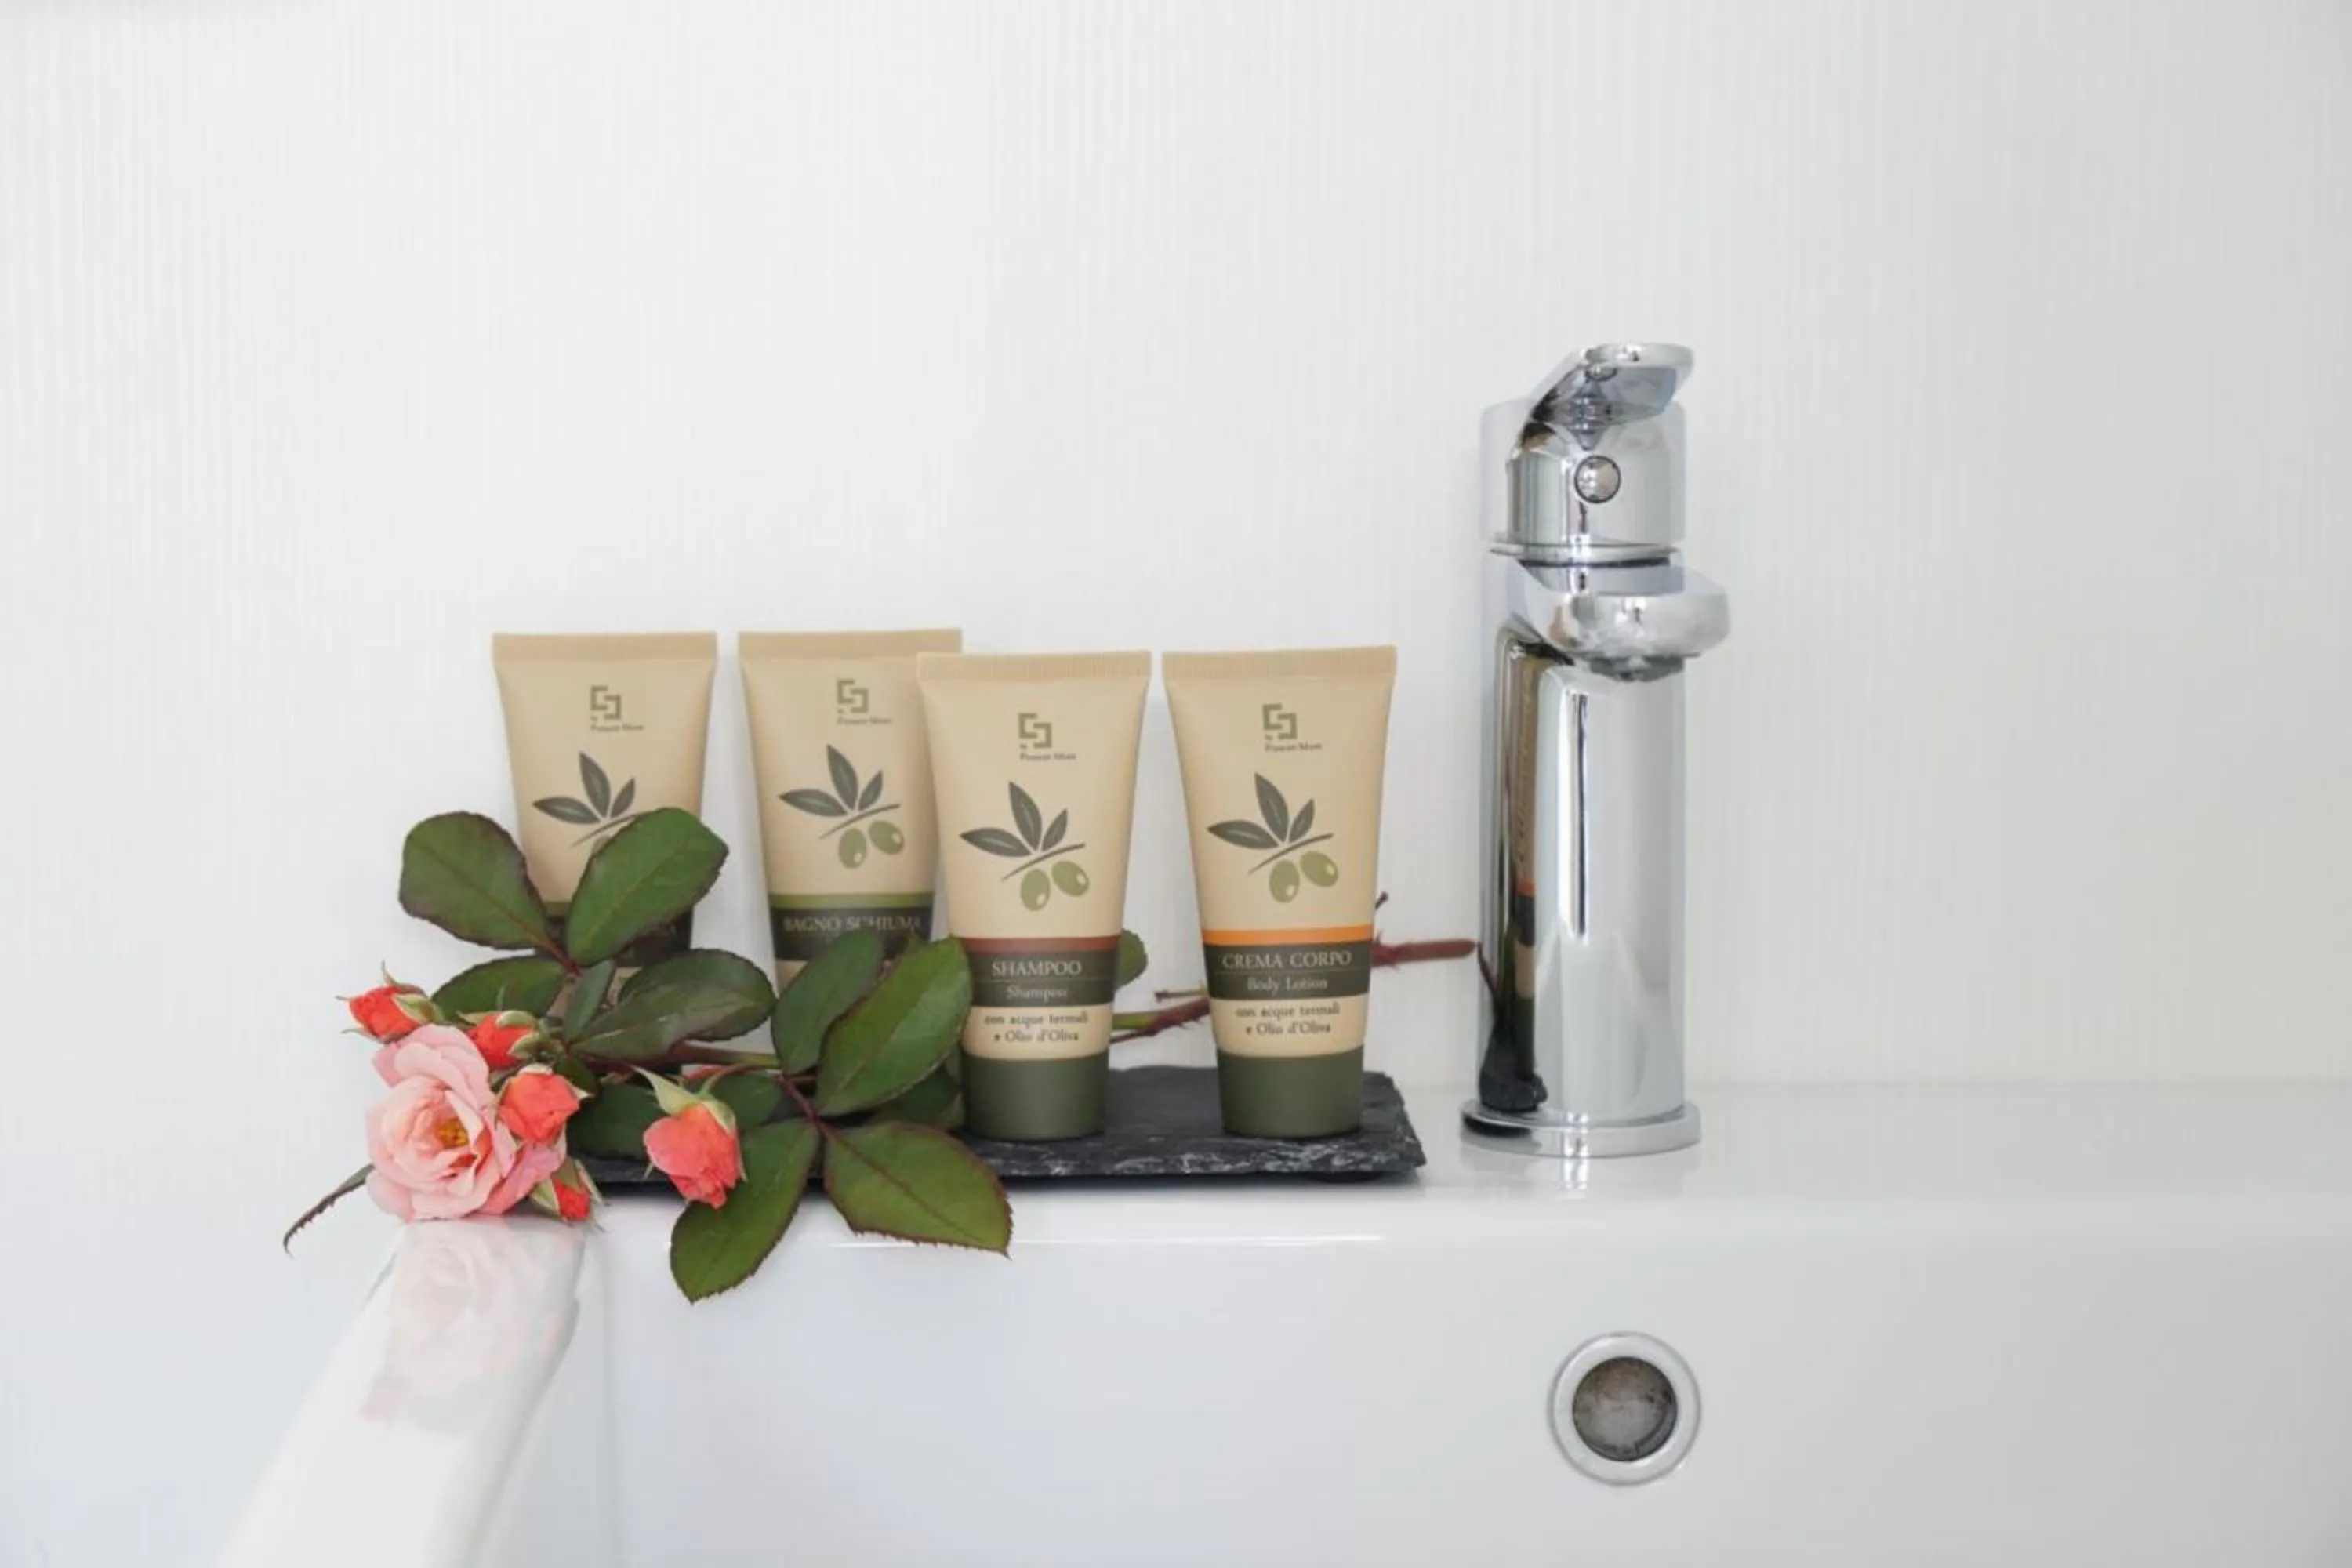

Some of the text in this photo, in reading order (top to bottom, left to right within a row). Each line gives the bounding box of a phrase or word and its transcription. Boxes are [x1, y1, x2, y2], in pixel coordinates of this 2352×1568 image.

[783, 916, 843, 931] BAGNO
[992, 960, 1083, 976] SHAMPOO
[1222, 950, 1352, 969] CREMA CORPO
[1006, 985, 1068, 1003] Shampoo
[1247, 977, 1328, 996] Body Lotion
